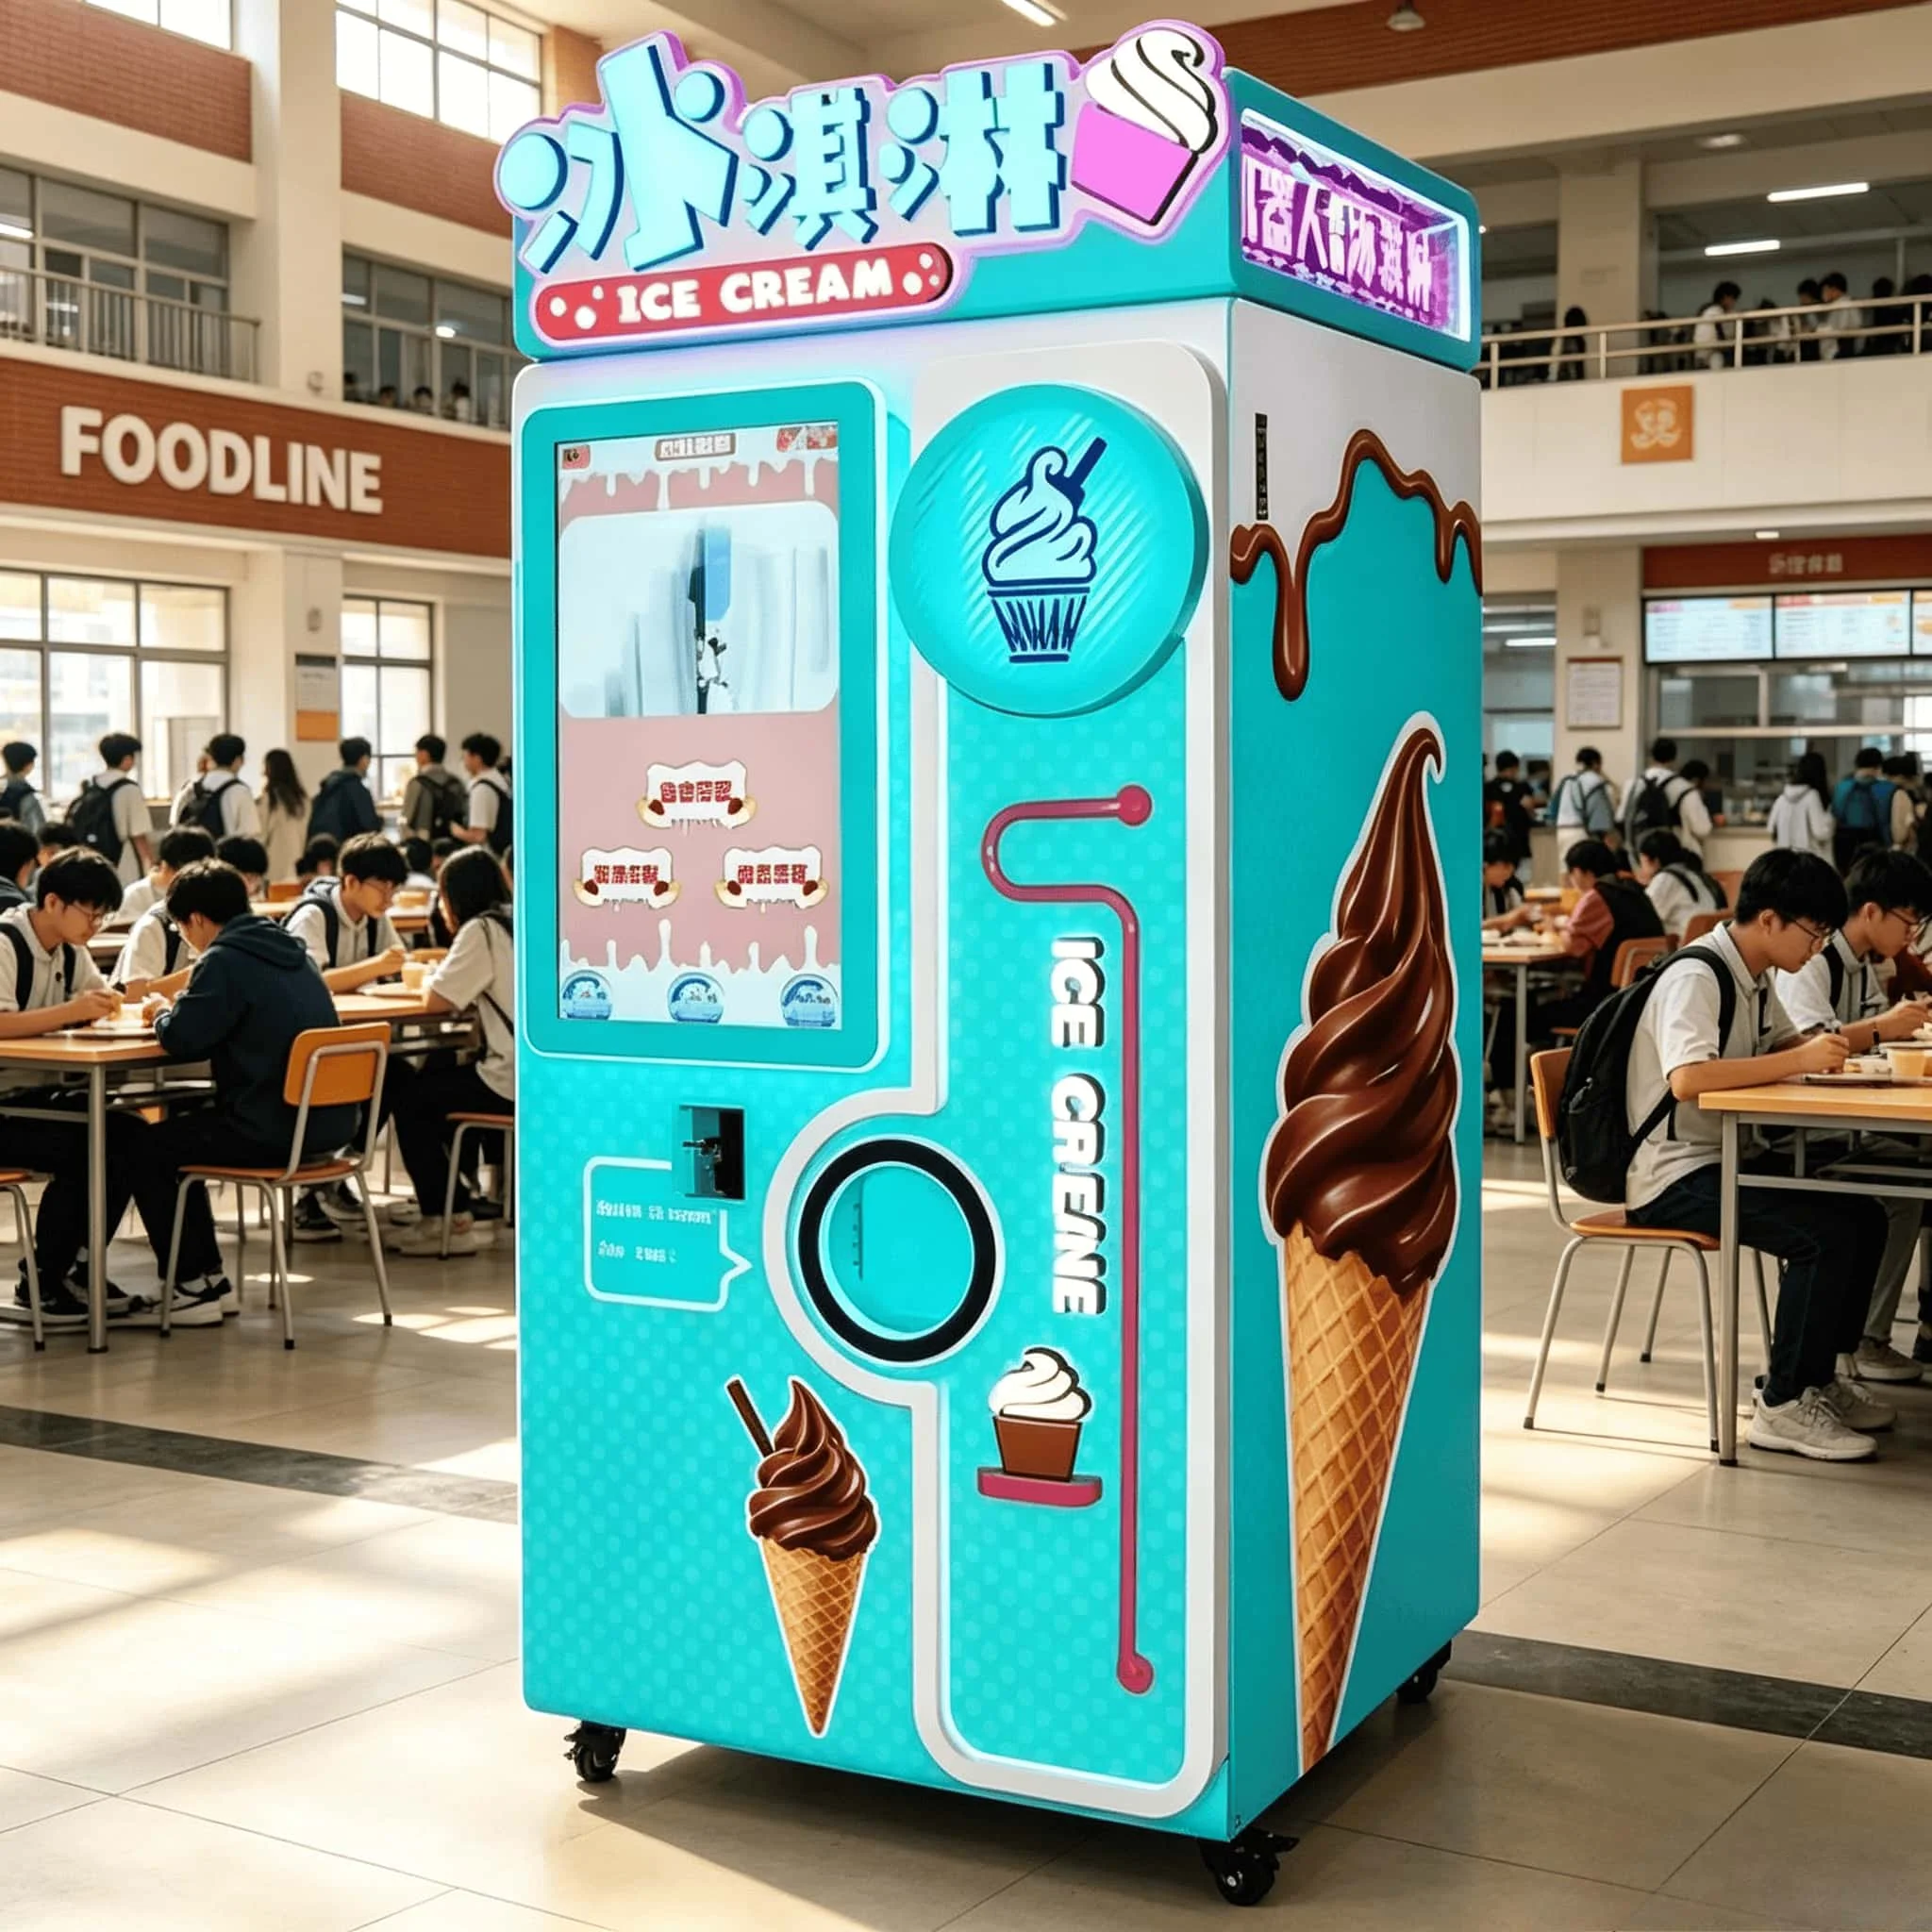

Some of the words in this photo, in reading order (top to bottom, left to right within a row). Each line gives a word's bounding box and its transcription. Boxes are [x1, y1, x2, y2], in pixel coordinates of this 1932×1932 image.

[499, 41, 1065, 273] 冰淇淋
[617, 279, 702, 325] ICE
[720, 257, 893, 314] CREAM
[61, 406, 383, 514] FOODLINE
[1050, 936, 1105, 1048] ICE
